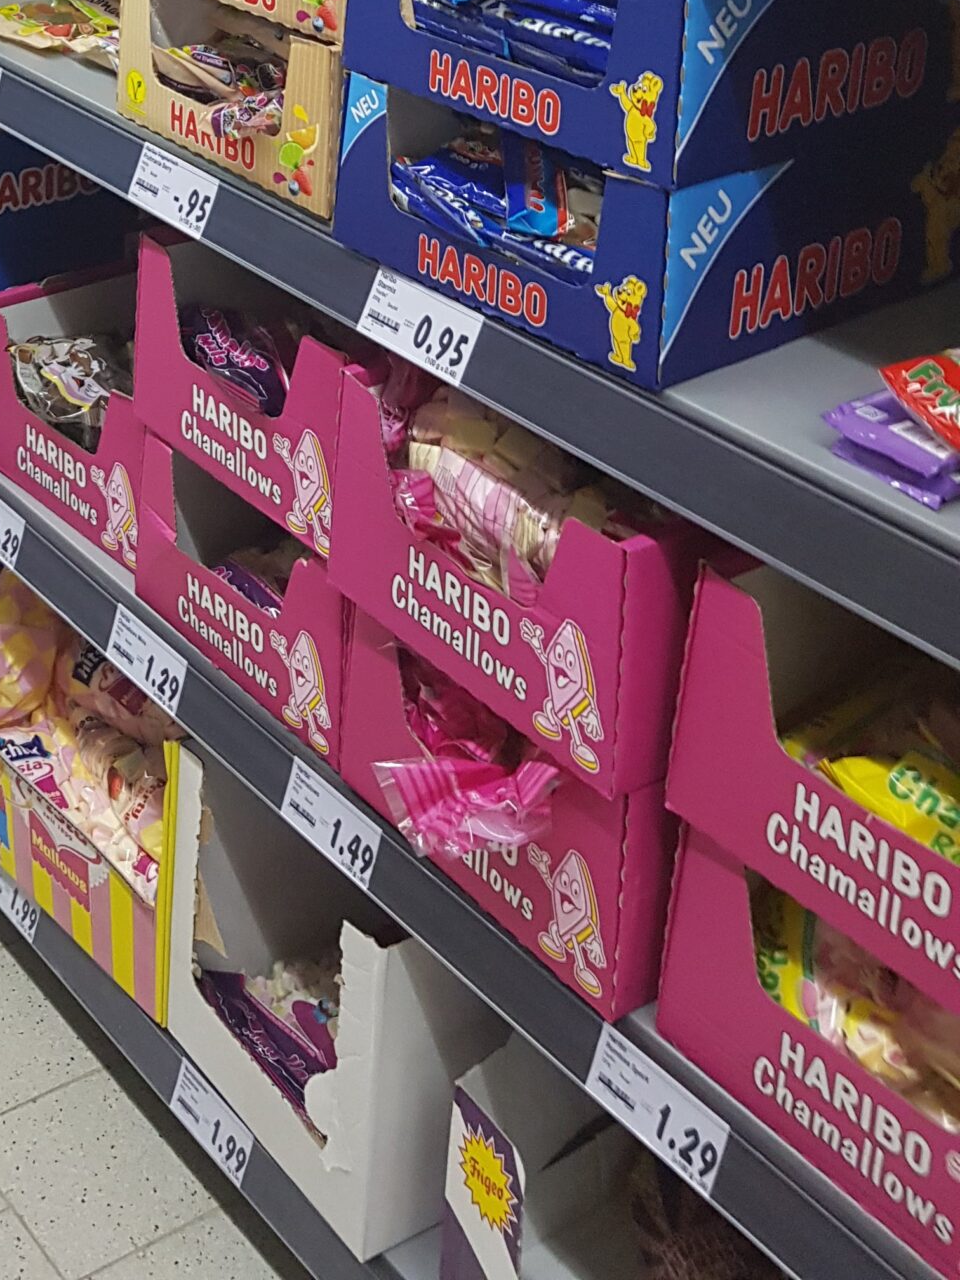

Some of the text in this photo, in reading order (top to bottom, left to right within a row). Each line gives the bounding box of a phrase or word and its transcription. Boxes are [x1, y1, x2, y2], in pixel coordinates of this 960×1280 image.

[349, 88, 381, 124] NEU
[428, 48, 562, 136] HARIBO
[747, 28, 929, 143] HARIBO
[173, 188, 211, 223] -.95
[680, 188, 734, 272] NEU
[417, 231, 549, 327] HARIBO
[728, 217, 904, 340] HARIBO
[413, 314, 470, 367] 0.95
[25, 423, 87, 488] HARIBO
[180, 410, 283, 506] Chamallows
[192, 383, 268, 461] HARIBO
[16, 444, 99, 526] Chamallows
[186, 572, 265, 654] HARIBO
[407, 545, 511, 647] HARIBO
[144, 652, 180, 703] 1.29
[177, 599, 278, 698] Chamallows
[391, 573, 528, 702] Chamallows
[31, 828, 88, 895] Mallows
[328, 817, 375, 875] 1.49
[461, 843, 534, 922] allows
[794, 781, 953, 919] HARIBO
[9, 886, 38, 931] 1.99
[210, 1117, 248, 1174] 1.99
[654, 1103, 719, 1180] 1.29
[778, 1031, 933, 1178] HARIBO
[469, 1156, 504, 1201] Frigeo
[752, 1055, 955, 1246] Chamallows
